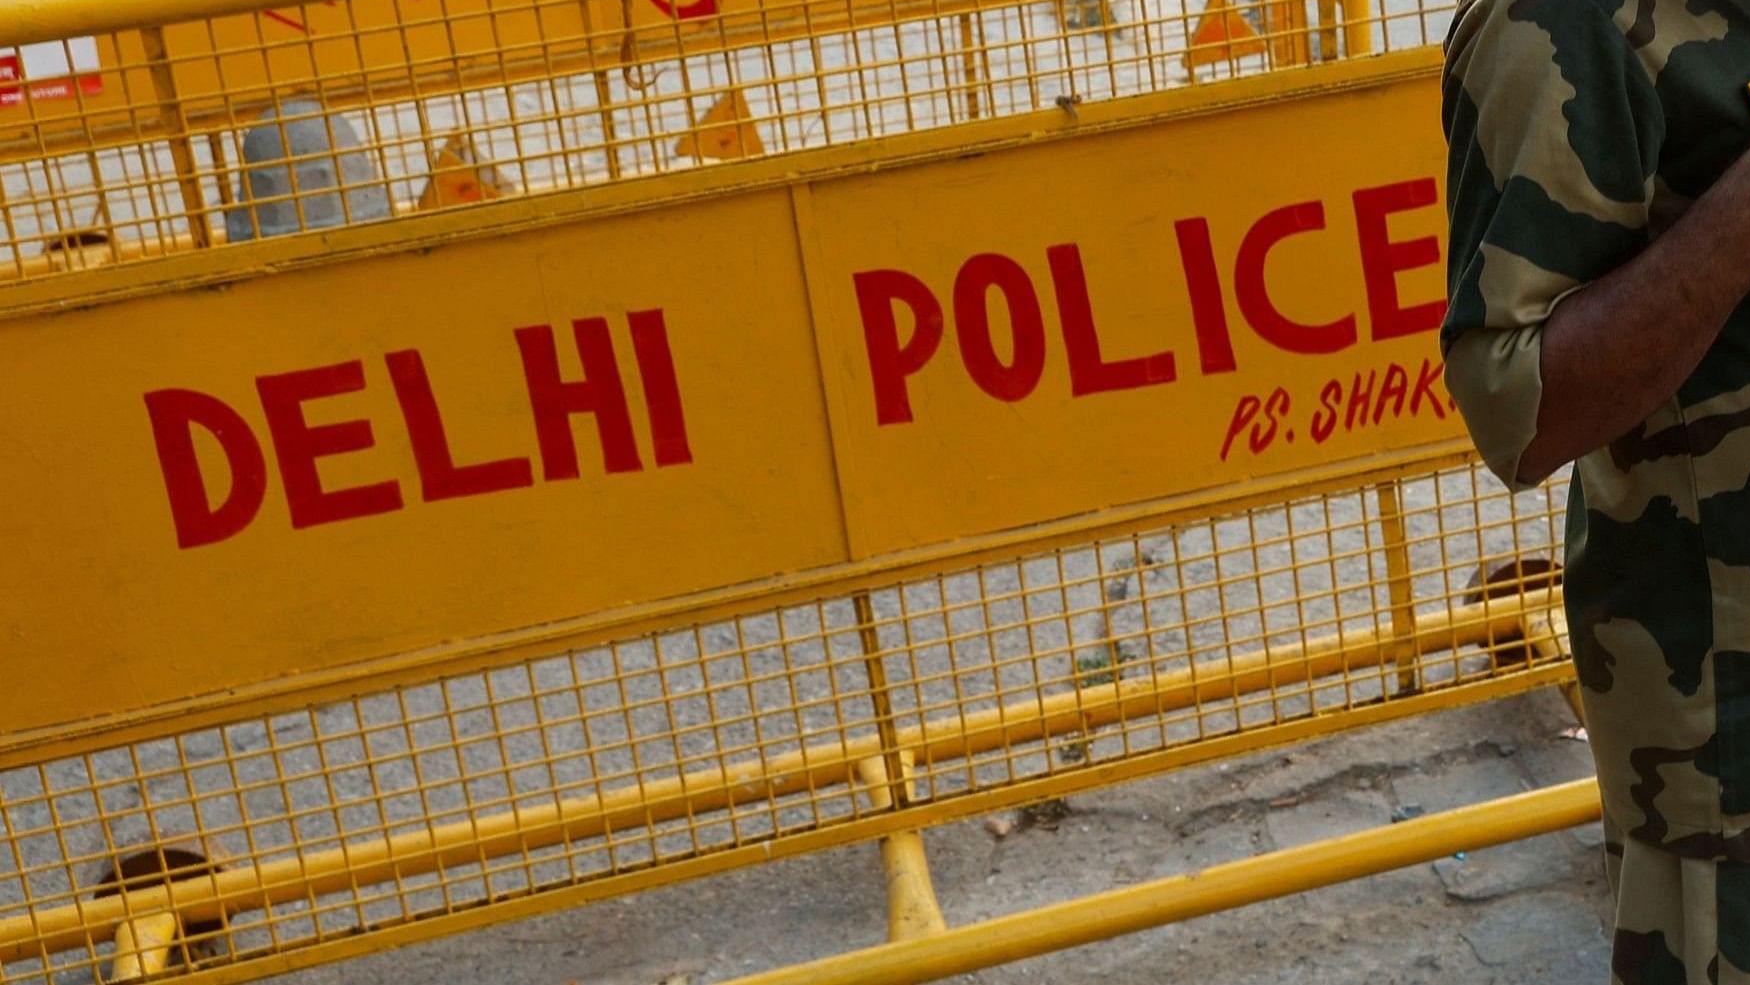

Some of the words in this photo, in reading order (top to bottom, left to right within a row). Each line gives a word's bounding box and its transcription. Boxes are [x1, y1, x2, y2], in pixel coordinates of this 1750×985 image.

[143, 308, 693, 550] DELHI
[852, 177, 1450, 427] POLICE
[1219, 385, 1296, 462] PS.
[1309, 357, 1457, 445] SHAK
